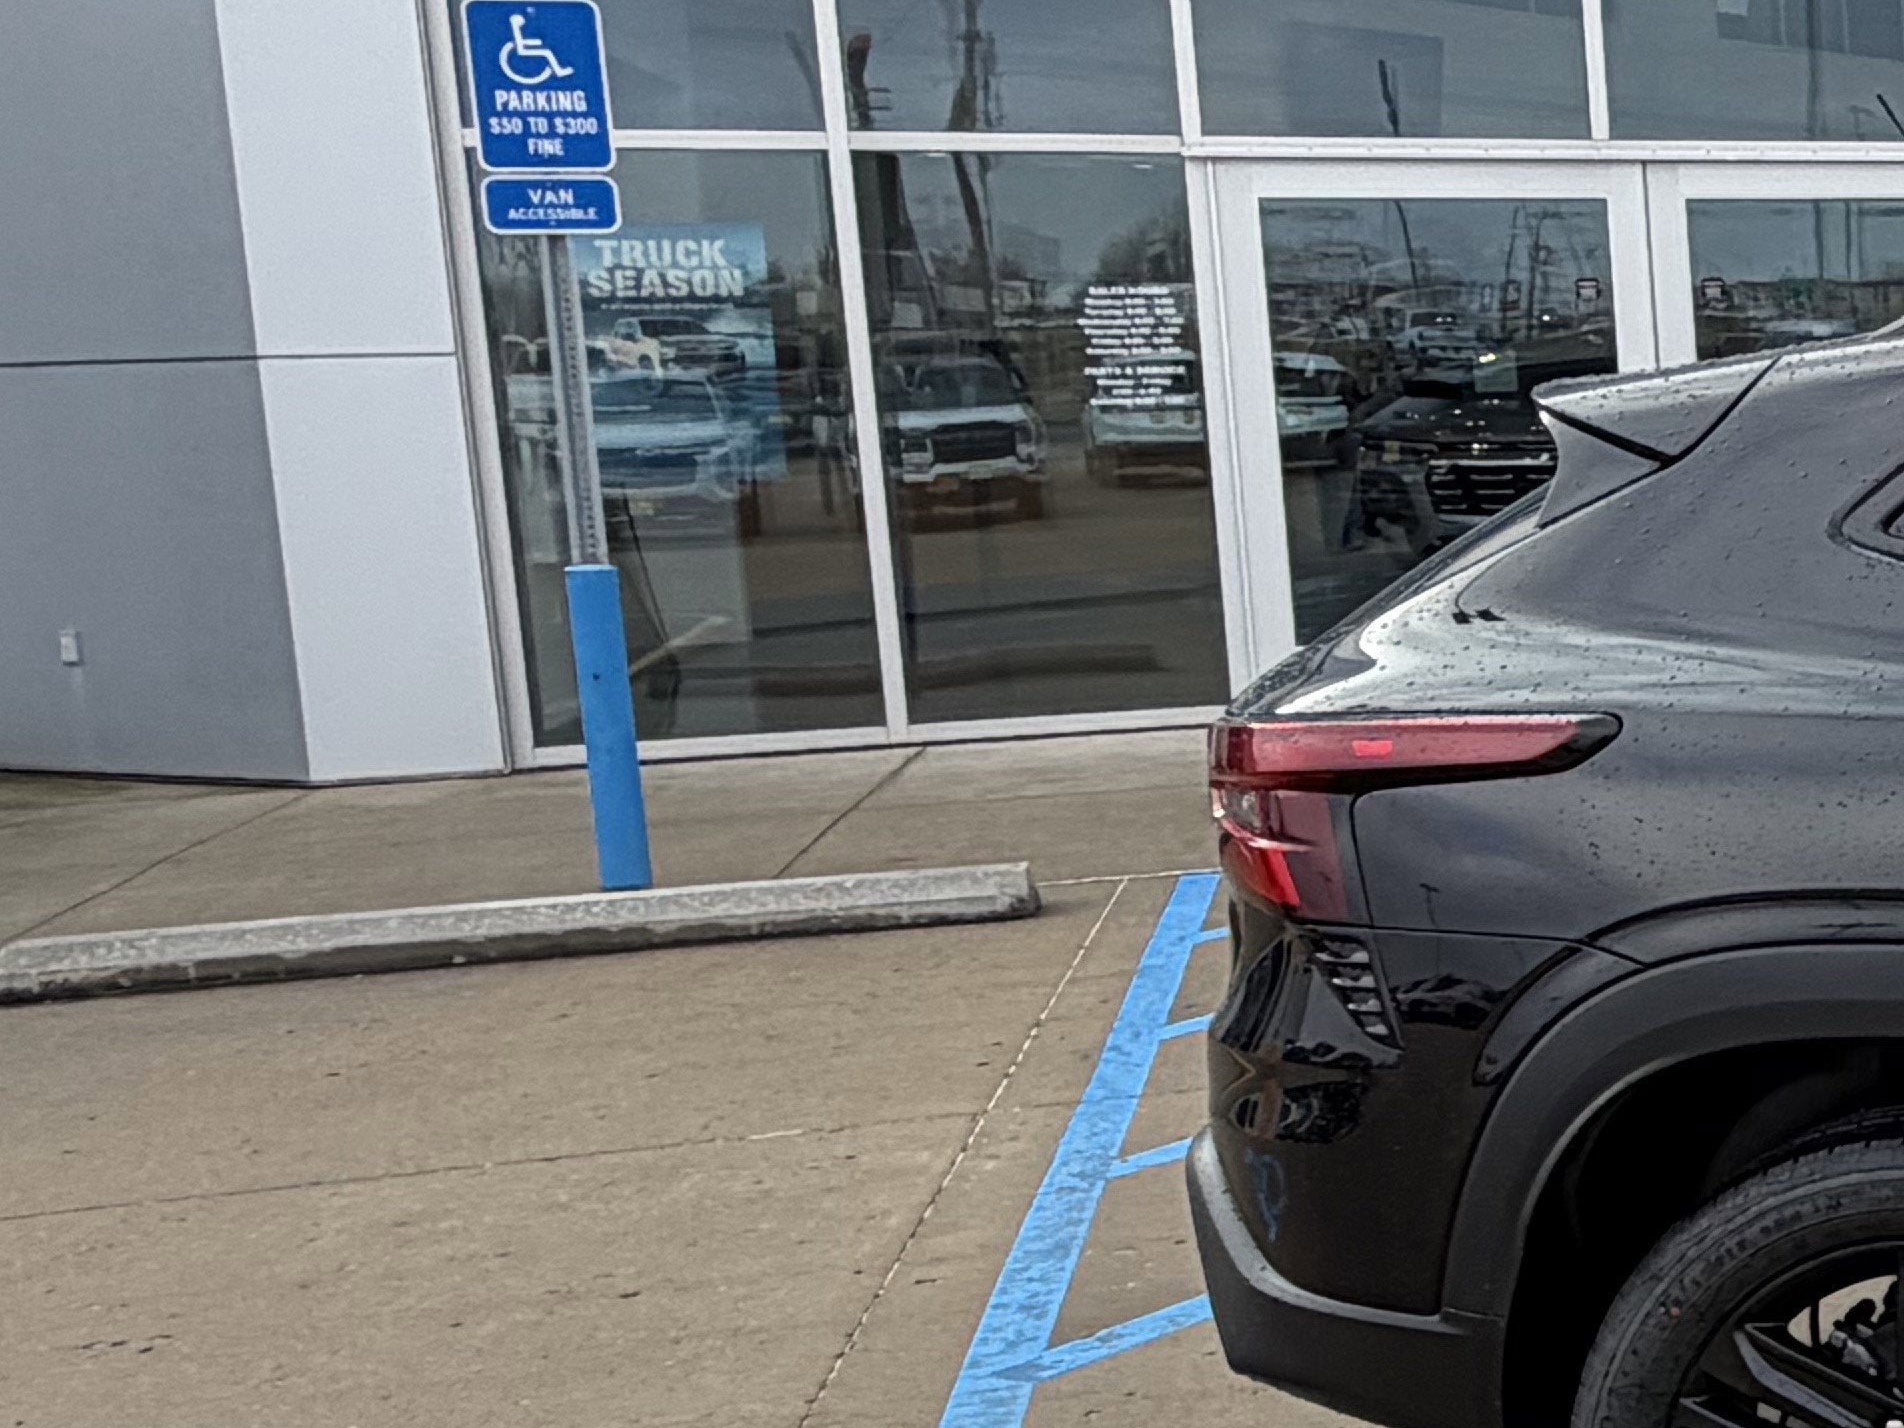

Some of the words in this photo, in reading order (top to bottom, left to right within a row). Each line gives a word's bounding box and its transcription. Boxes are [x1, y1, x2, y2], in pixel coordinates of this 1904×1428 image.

[495, 89, 588, 113] PARKING
[488, 116, 523, 135] $50
[527, 117, 549, 134] TO
[555, 117, 599, 135] $300
[527, 138, 565, 156] FINE
[527, 188, 575, 205] VAN
[507, 207, 599, 221] ACCESSIBLE
[592, 238, 730, 269] TRUCK
[586, 268, 745, 298] SEASON
